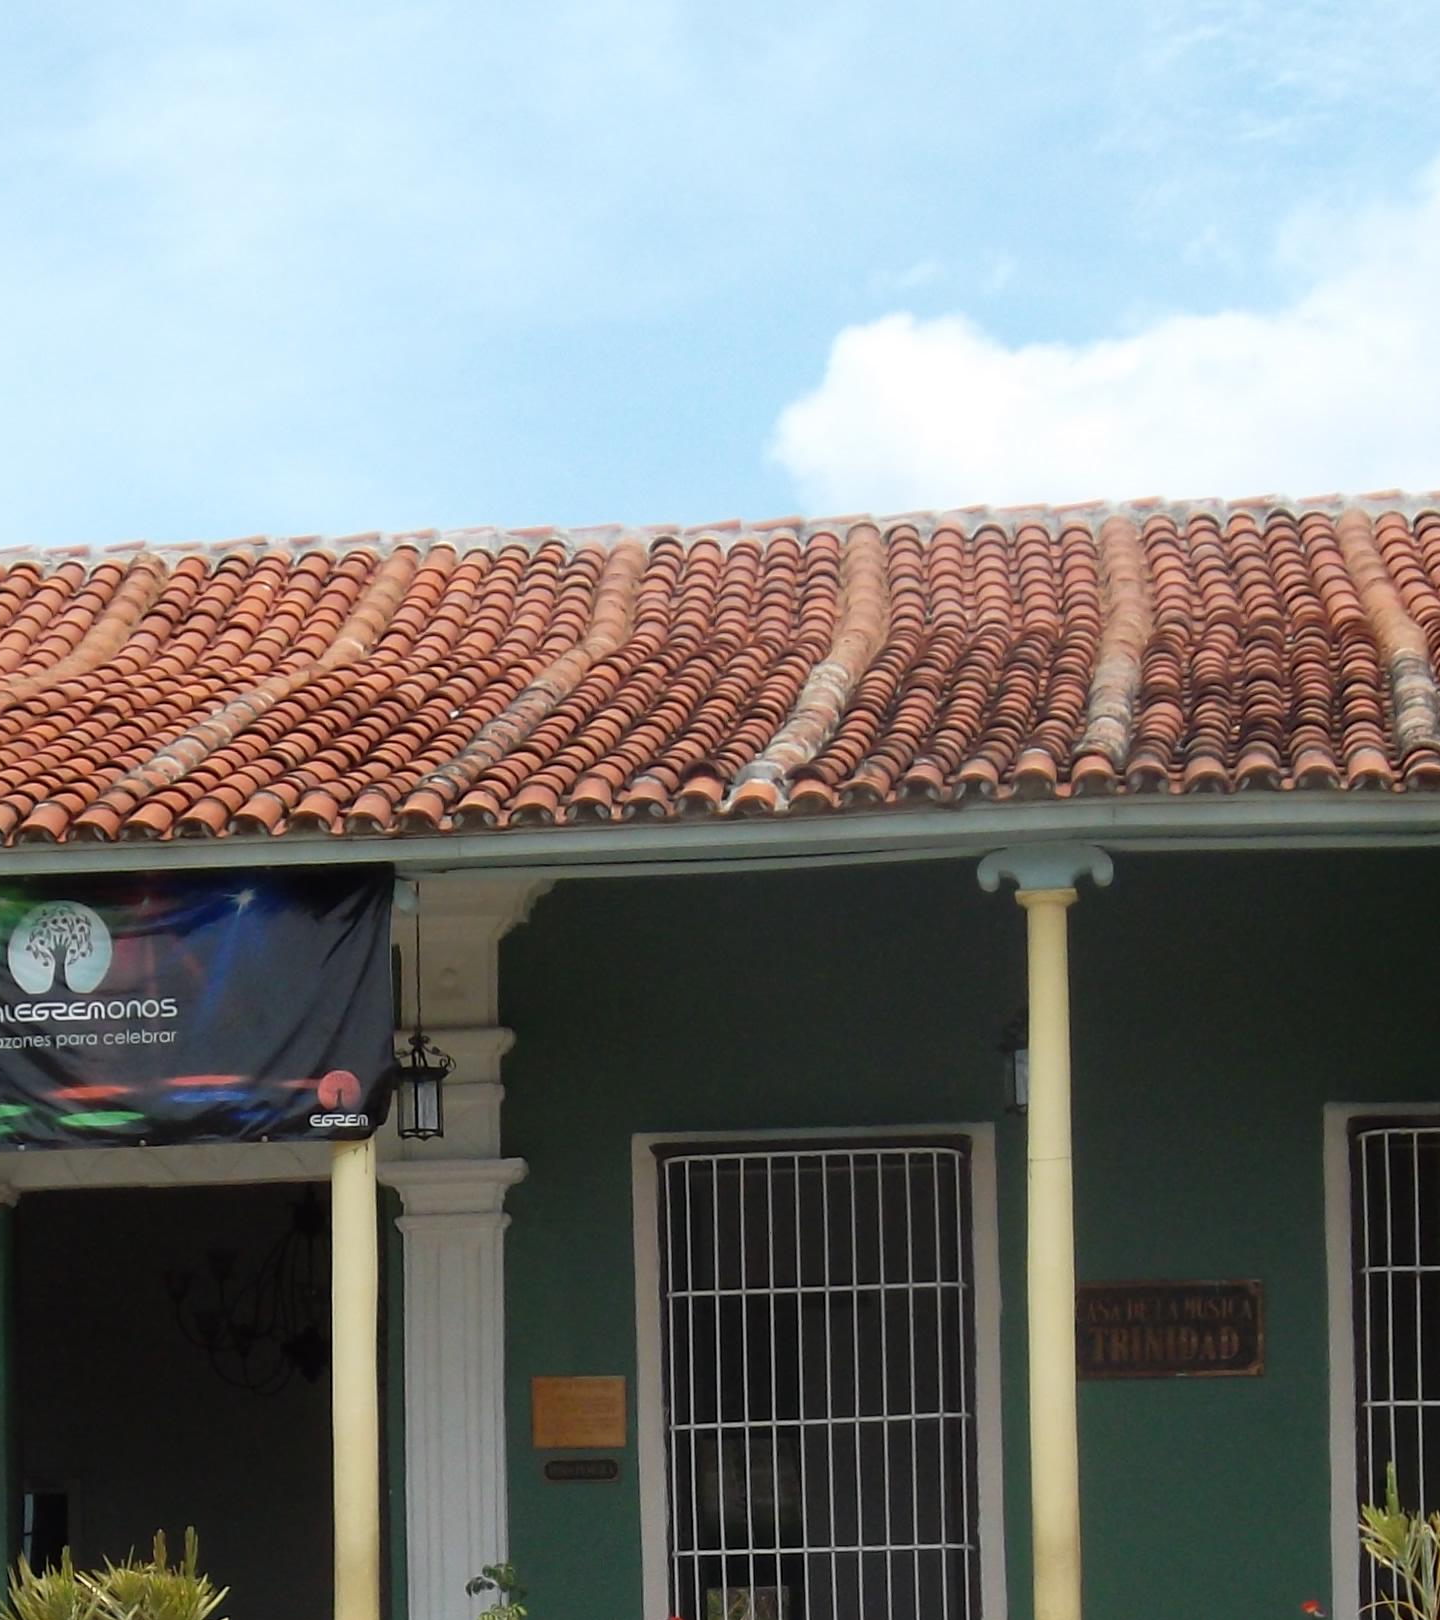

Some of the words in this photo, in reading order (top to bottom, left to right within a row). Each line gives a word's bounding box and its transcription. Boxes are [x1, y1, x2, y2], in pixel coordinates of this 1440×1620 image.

[56, 1032, 98, 1049] para
[103, 1029, 177, 1046] celebrar
[309, 1113, 369, 1128] EGREM
[1087, 1326, 1241, 1361] TRINIDAD
